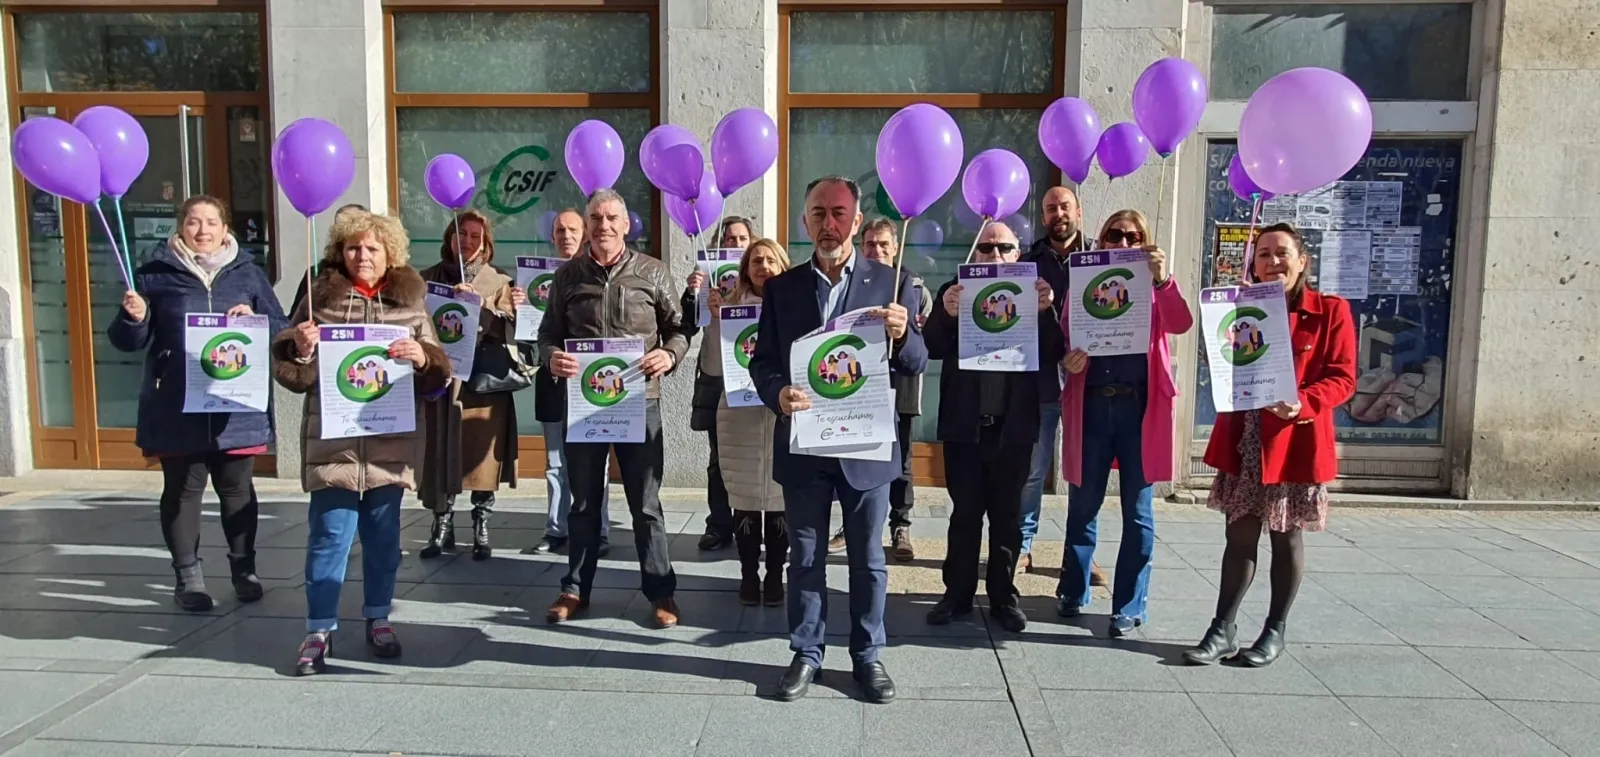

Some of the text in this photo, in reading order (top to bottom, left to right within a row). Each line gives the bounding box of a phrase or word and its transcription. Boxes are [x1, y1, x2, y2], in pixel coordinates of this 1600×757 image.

[1402, 156, 1455, 168] nueva
[503, 170, 557, 192] CSIF
[524, 259, 540, 267] 25N
[1080, 254, 1101, 264] 25N
[969, 267, 989, 276] 25N
[433, 286, 449, 295] 25N
[1210, 291, 1228, 301] 25N
[730, 308, 748, 317] 25N
[197, 317, 218, 325] 25N
[331, 329, 355, 339] 25N
[576, 342, 595, 351] 25N
[814, 410, 874, 424] Te escuchamos
